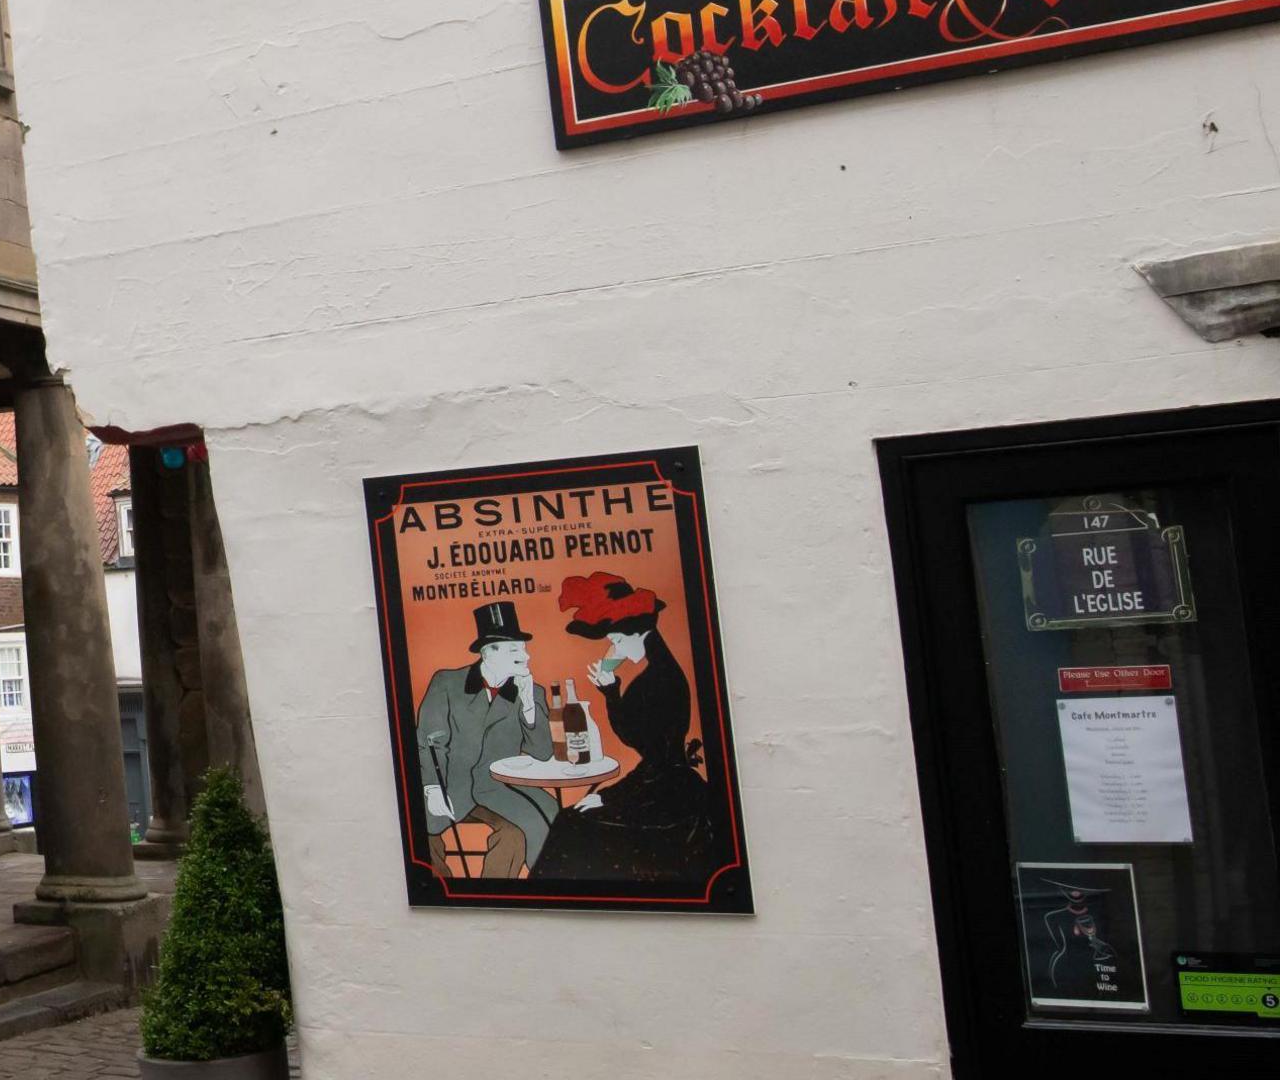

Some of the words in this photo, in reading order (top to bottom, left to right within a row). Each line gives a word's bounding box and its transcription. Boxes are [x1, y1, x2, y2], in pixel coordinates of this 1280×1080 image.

[399, 483, 674, 534] ABSINTHE
[477, 521, 593, 538] EXTRA-SUPÉRIEURE
[1083, 515, 1110, 529] 147
[427, 545, 446, 569] J.
[450, 536, 555, 568] ÉDOUARD
[565, 528, 655, 558] PERNOT
[1082, 545, 1119, 567] RUE
[1091, 570, 1115, 589] DE
[412, 577, 536, 602] MONTBÉLIARD
[1074, 591, 1145, 614] L'EGLISE
[1063, 670, 1090, 679] Please
[1094, 670, 1110, 678] Use
[1113, 669, 1139, 678] Other
[1143, 668, 1166, 677] Door
[1071, 711, 1092, 721] Cafe
[1094, 709, 1157, 720] Montmartre
[1094, 963, 1117, 973] Time
[1096, 982, 1118, 992] Wine
[1265, 995, 1276, 1008] 5
